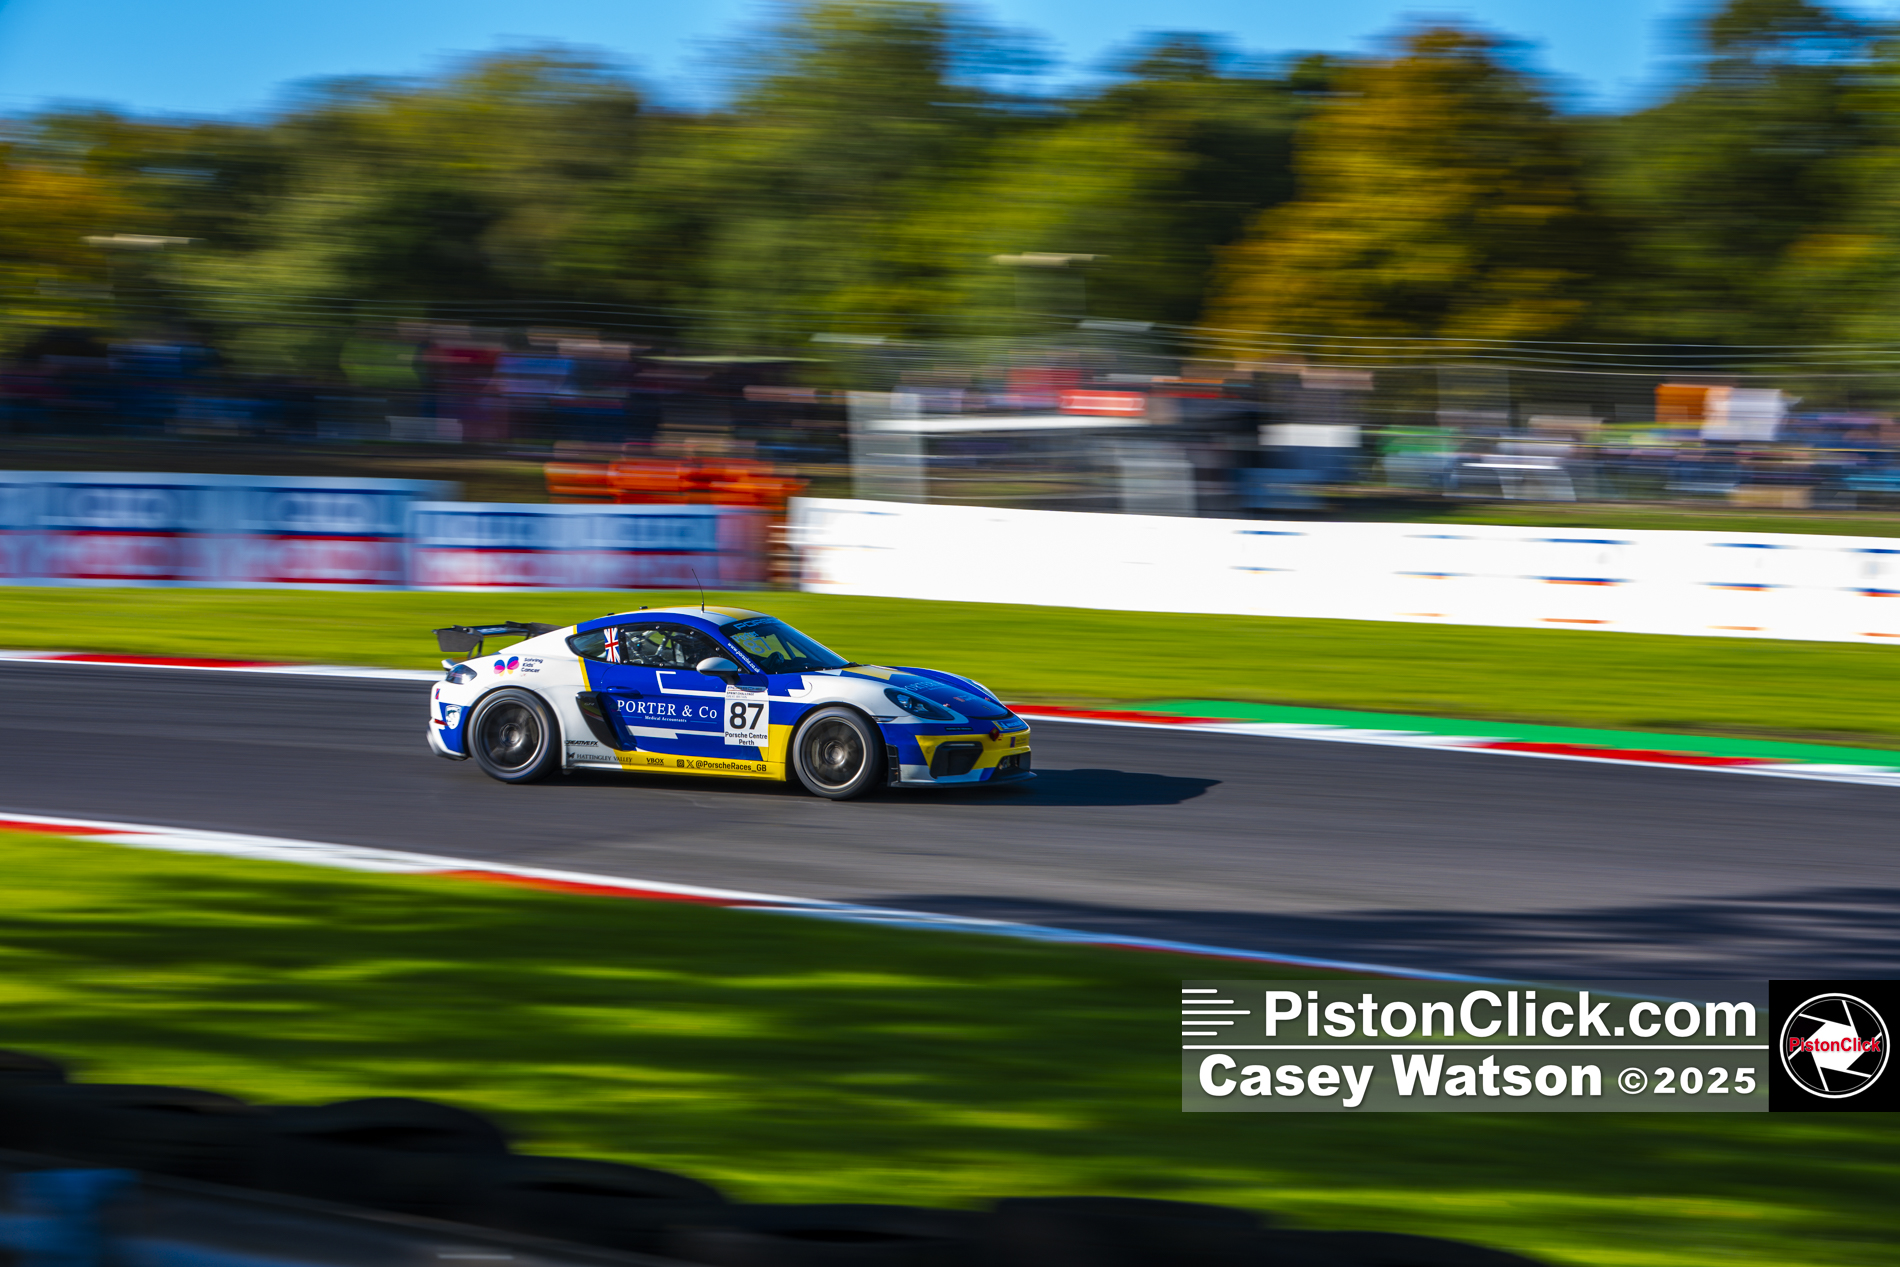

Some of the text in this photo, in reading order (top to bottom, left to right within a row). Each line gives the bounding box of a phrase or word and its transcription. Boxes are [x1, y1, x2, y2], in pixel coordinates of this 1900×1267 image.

[743, 637, 772, 654] 87
[617, 699, 717, 719] PORTER & Co
[729, 702, 764, 731] 87
[725, 731, 748, 739] Porsche
[739, 738, 755, 746] Perth
[577, 753, 612, 761] HATTINGLEY
[696, 760, 767, 772] @PorscheRaces_GB
